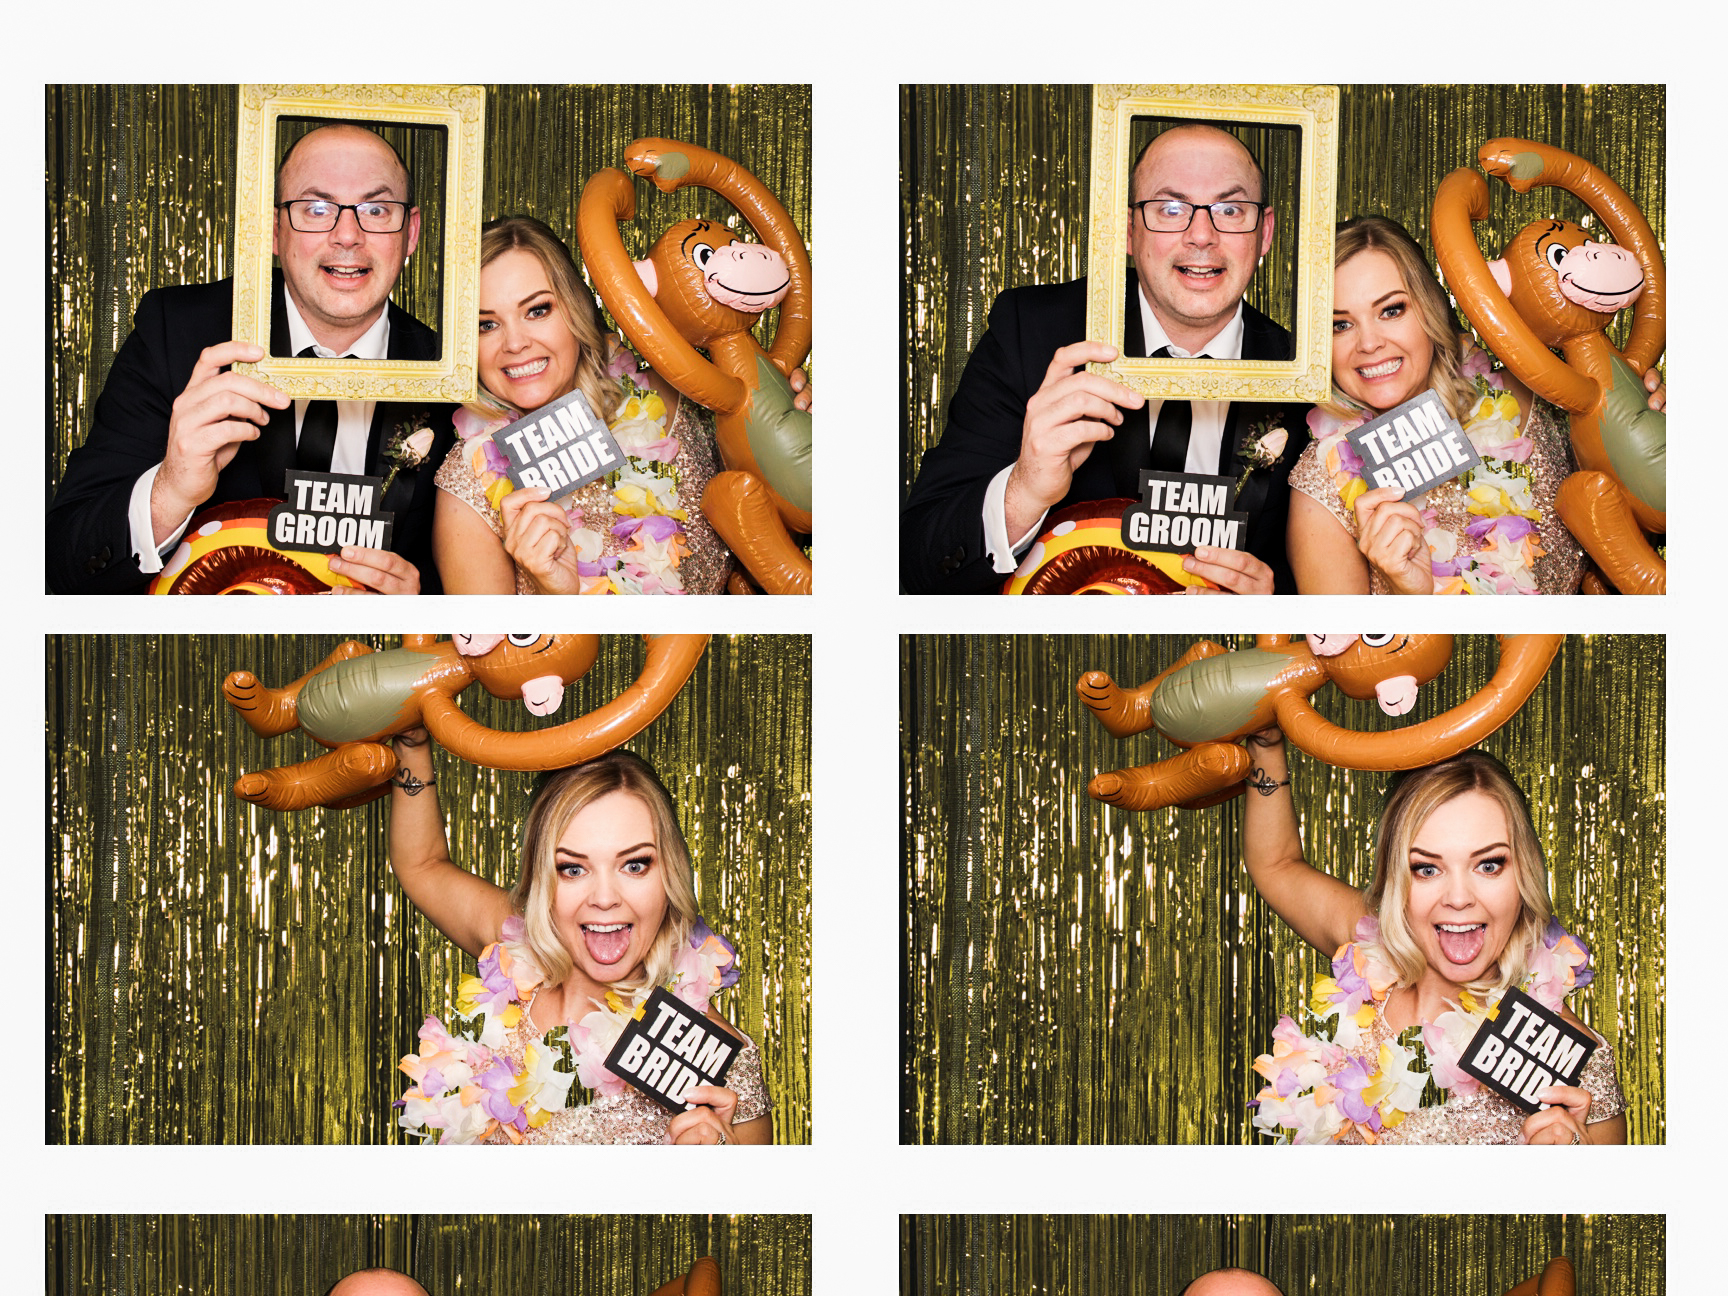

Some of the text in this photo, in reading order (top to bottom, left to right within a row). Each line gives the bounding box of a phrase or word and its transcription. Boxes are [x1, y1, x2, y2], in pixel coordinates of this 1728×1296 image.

[503, 400, 593, 466] TEAM
[517, 430, 617, 493] BRIDE
[1357, 400, 1447, 466] TEAM
[1371, 430, 1471, 493] BRIDE
[293, 479, 374, 516] TEAM
[1147, 479, 1228, 516] TEAM
[274, 511, 386, 551] GROOM
[1128, 511, 1240, 551] GROOM
[646, 1000, 733, 1079] TEAM
[1500, 1000, 1587, 1079] TEAM
